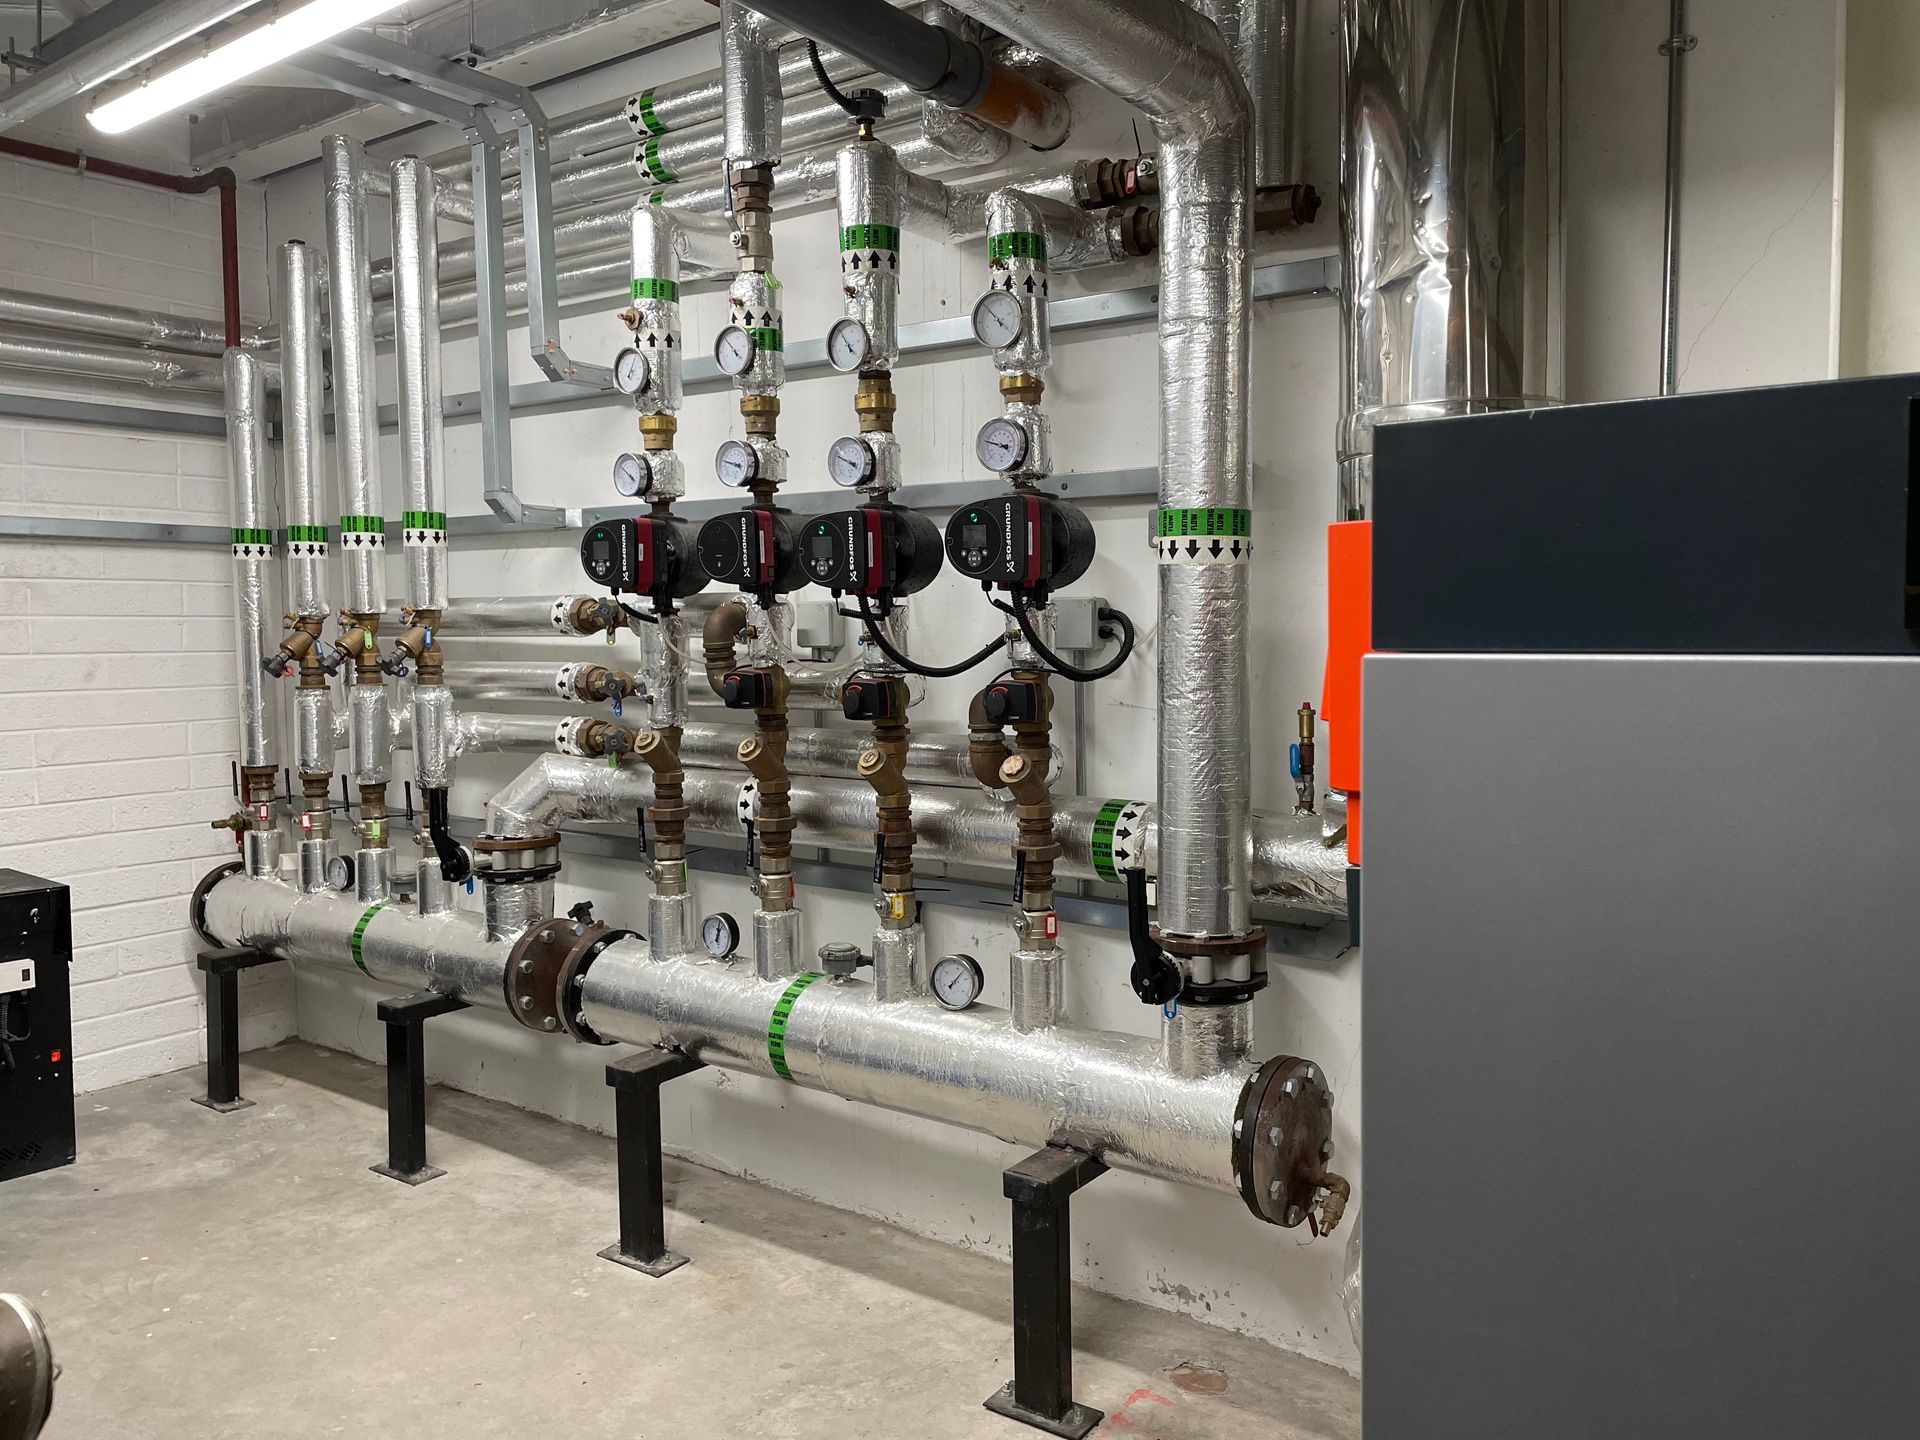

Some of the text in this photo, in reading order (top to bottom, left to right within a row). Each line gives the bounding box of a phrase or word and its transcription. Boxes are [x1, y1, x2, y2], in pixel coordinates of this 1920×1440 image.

[1190, 513, 1198, 531] FLOW
[1207, 509, 1215, 535] HEATING
[847, 516, 855, 571] GRUNDFOS
[773, 1010, 789, 1019] HEATING
[773, 1018, 784, 1026] FLOW
[768, 1032, 784, 1040] HEATING
[770, 1040, 781, 1048] FLOW
